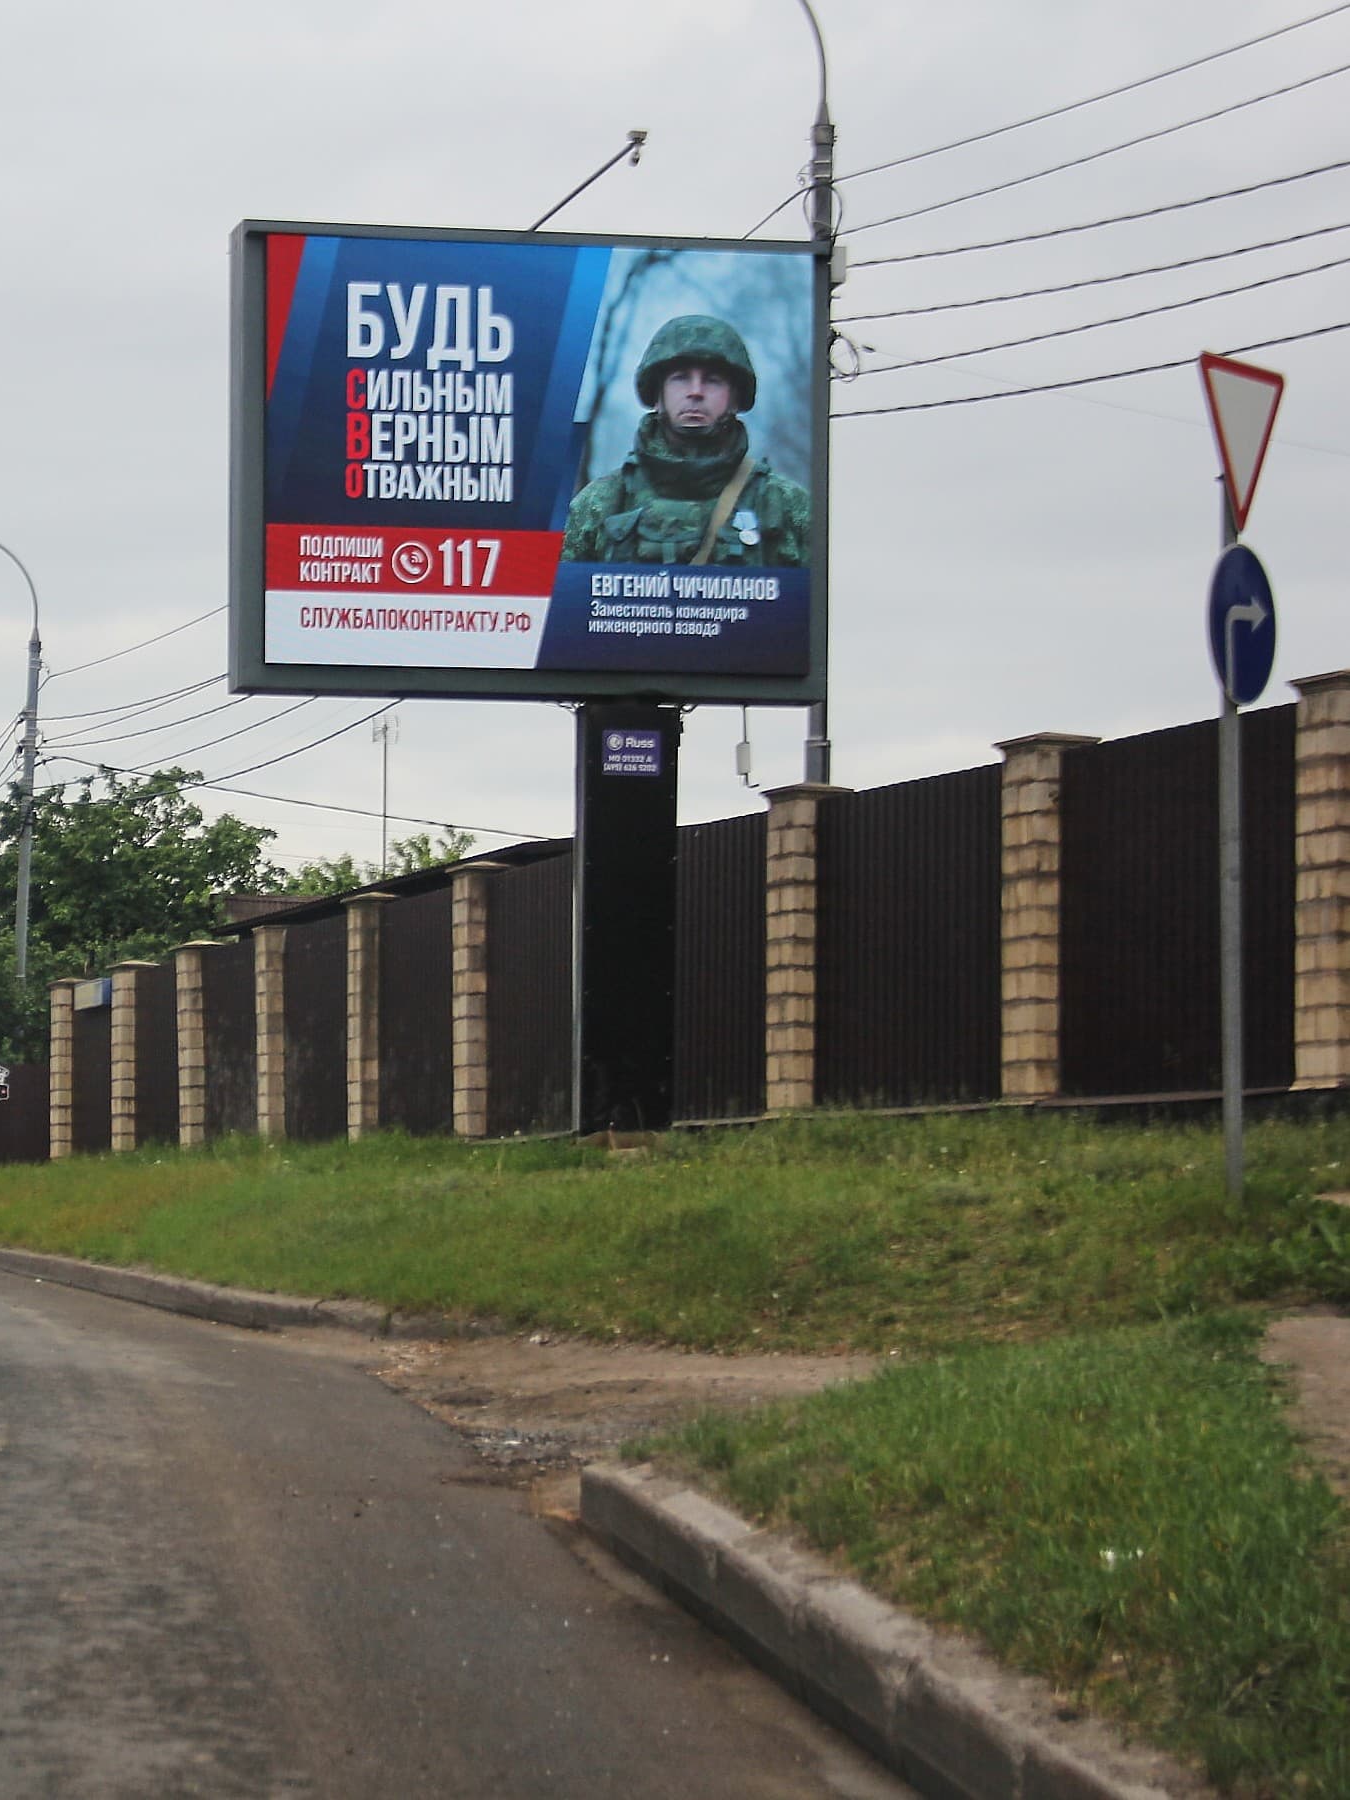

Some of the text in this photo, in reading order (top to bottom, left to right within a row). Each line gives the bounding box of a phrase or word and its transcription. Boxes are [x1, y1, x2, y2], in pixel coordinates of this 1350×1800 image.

[346, 281, 514, 372] БУДЬ
[346, 367, 514, 414] СИЛЬНЫМ
[346, 411, 514, 464] ВЕРНЫМ
[345, 461, 514, 503] ОТВАЖНЫМ
[299, 535, 383, 559] ПОДПИШИ
[299, 560, 382, 584] КОНТРАКТ
[438, 539, 501, 588] 117
[591, 571, 780, 601] ЕВГЕНИЙ ЧИЧИЛАНОВ
[300, 606, 532, 633] СЛУЖБАПОКОНТРАКТУ.РФ
[590, 601, 748, 623] Заместитель командира
[588, 620, 721, 637] инженерного взвода
[625, 737, 655, 749] Russ
